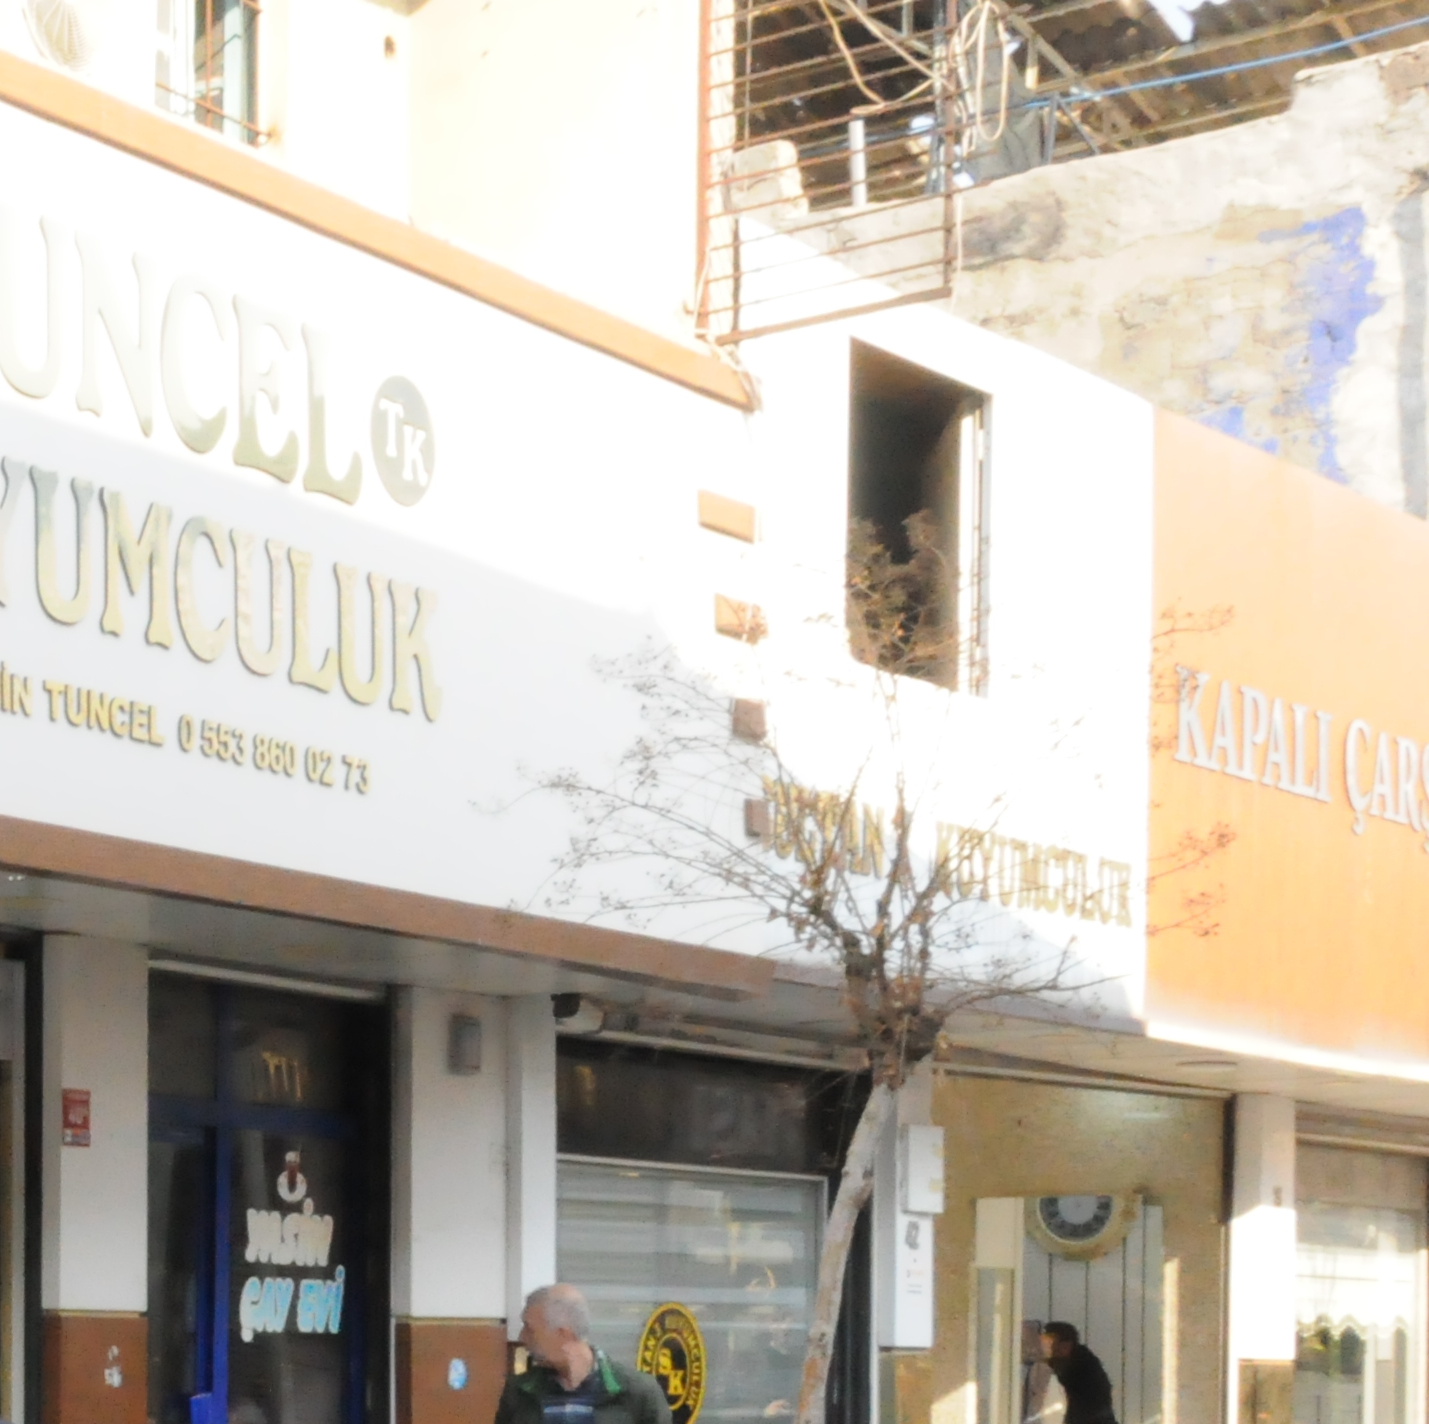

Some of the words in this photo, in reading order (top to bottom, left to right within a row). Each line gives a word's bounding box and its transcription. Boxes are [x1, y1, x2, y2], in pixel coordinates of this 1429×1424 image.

[43, 679, 164, 747] TUNCEL
[177, 713, 195, 753] 0
[200, 719, 245, 765] 553
[254, 732, 298, 777] 860
[304, 746, 335, 787] 02
[341, 754, 371, 795] 73
[1173, 664, 1332, 804] KAPALI
